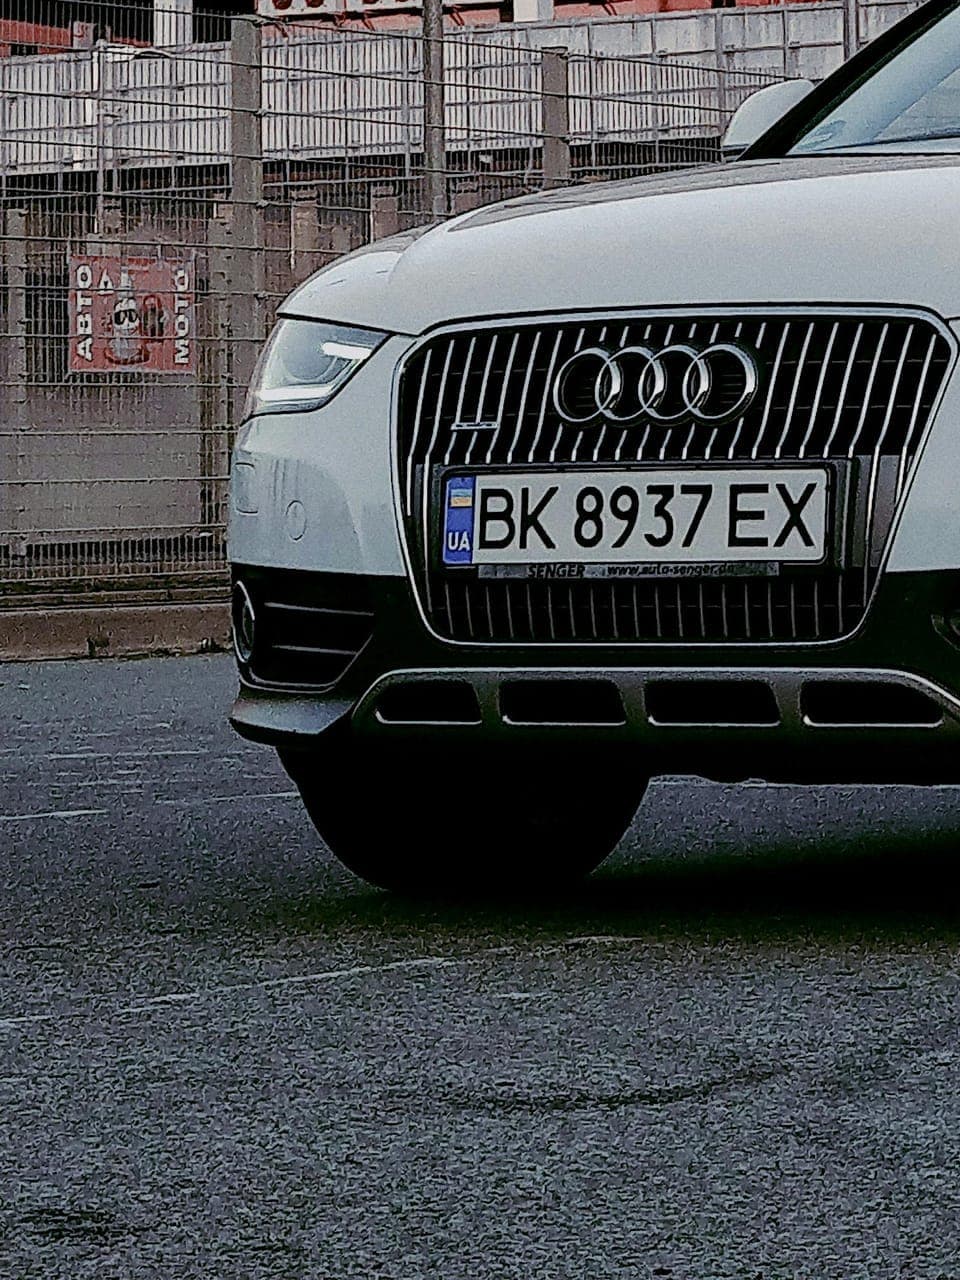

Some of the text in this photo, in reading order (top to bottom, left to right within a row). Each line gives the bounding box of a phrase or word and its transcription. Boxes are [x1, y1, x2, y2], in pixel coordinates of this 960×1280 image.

[76, 264, 93, 361] АВТО
[174, 269, 189, 364] МОТО
[448, 531, 471, 552] UA
[478, 482, 819, 550] BK 8937 EX
[527, 564, 586, 578] SENGER
